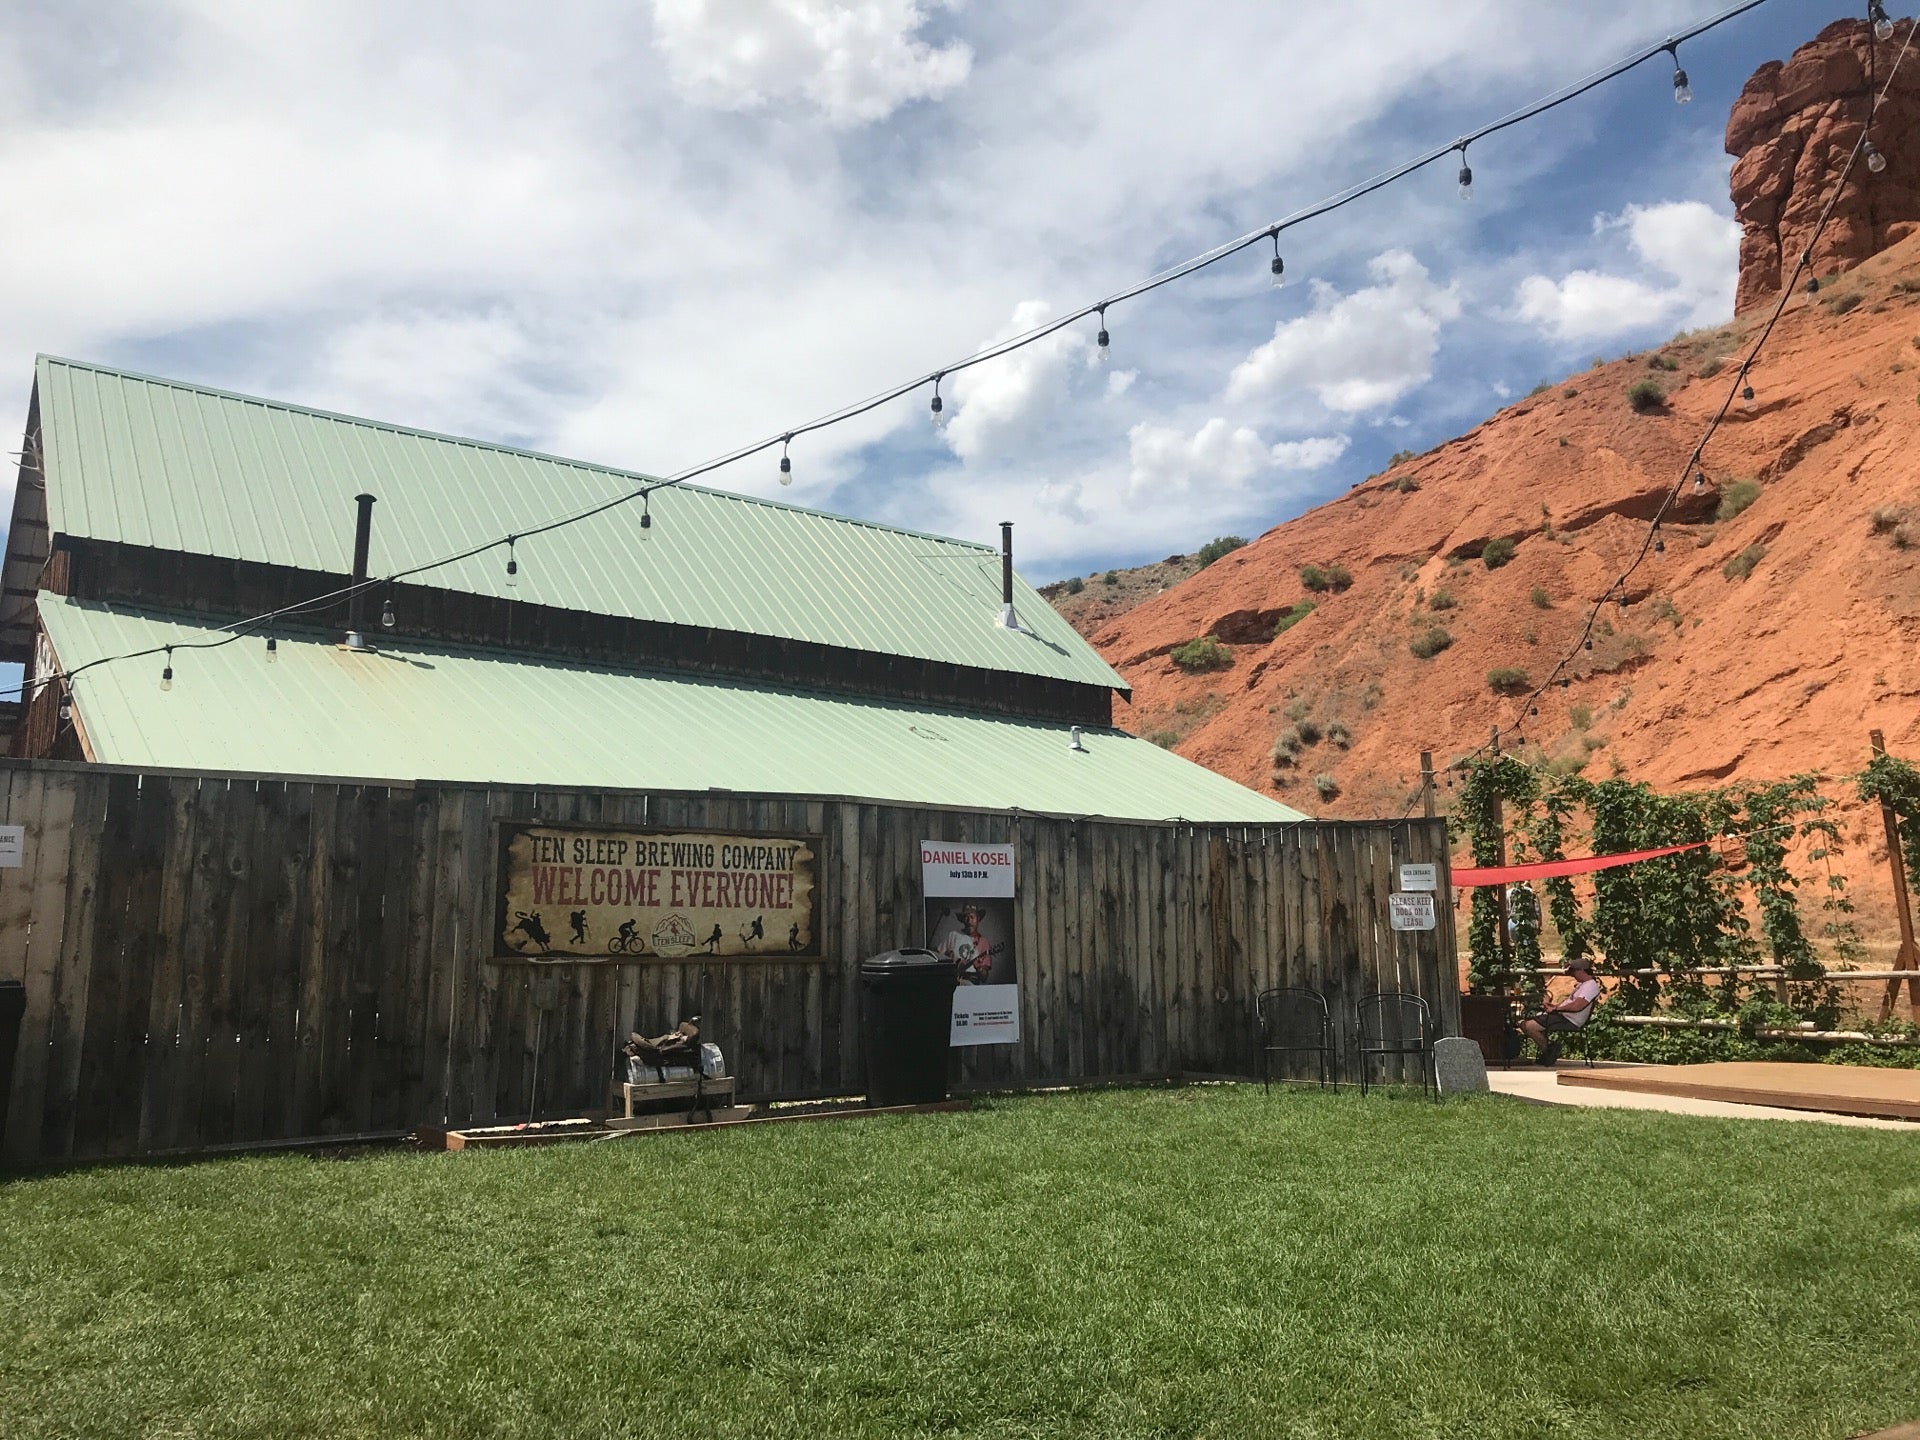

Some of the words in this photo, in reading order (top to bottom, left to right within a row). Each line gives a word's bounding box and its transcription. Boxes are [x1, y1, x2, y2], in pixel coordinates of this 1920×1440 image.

[530, 836, 565, 863] TEN
[573, 838, 628, 866] SLEEP
[635, 841, 715, 869] BREWING
[721, 844, 796, 871] COMPANY
[922, 850, 969, 865] DANIEL
[972, 852, 1011, 866] KOSEL
[949, 870, 960, 879] July
[532, 866, 661, 908] WELCOME
[671, 869, 794, 909] EVERYONE!
[1392, 897, 1415, 905] PLEASE
[1417, 897, 1431, 905] KEEP
[1404, 918, 1423, 926] LEASH
